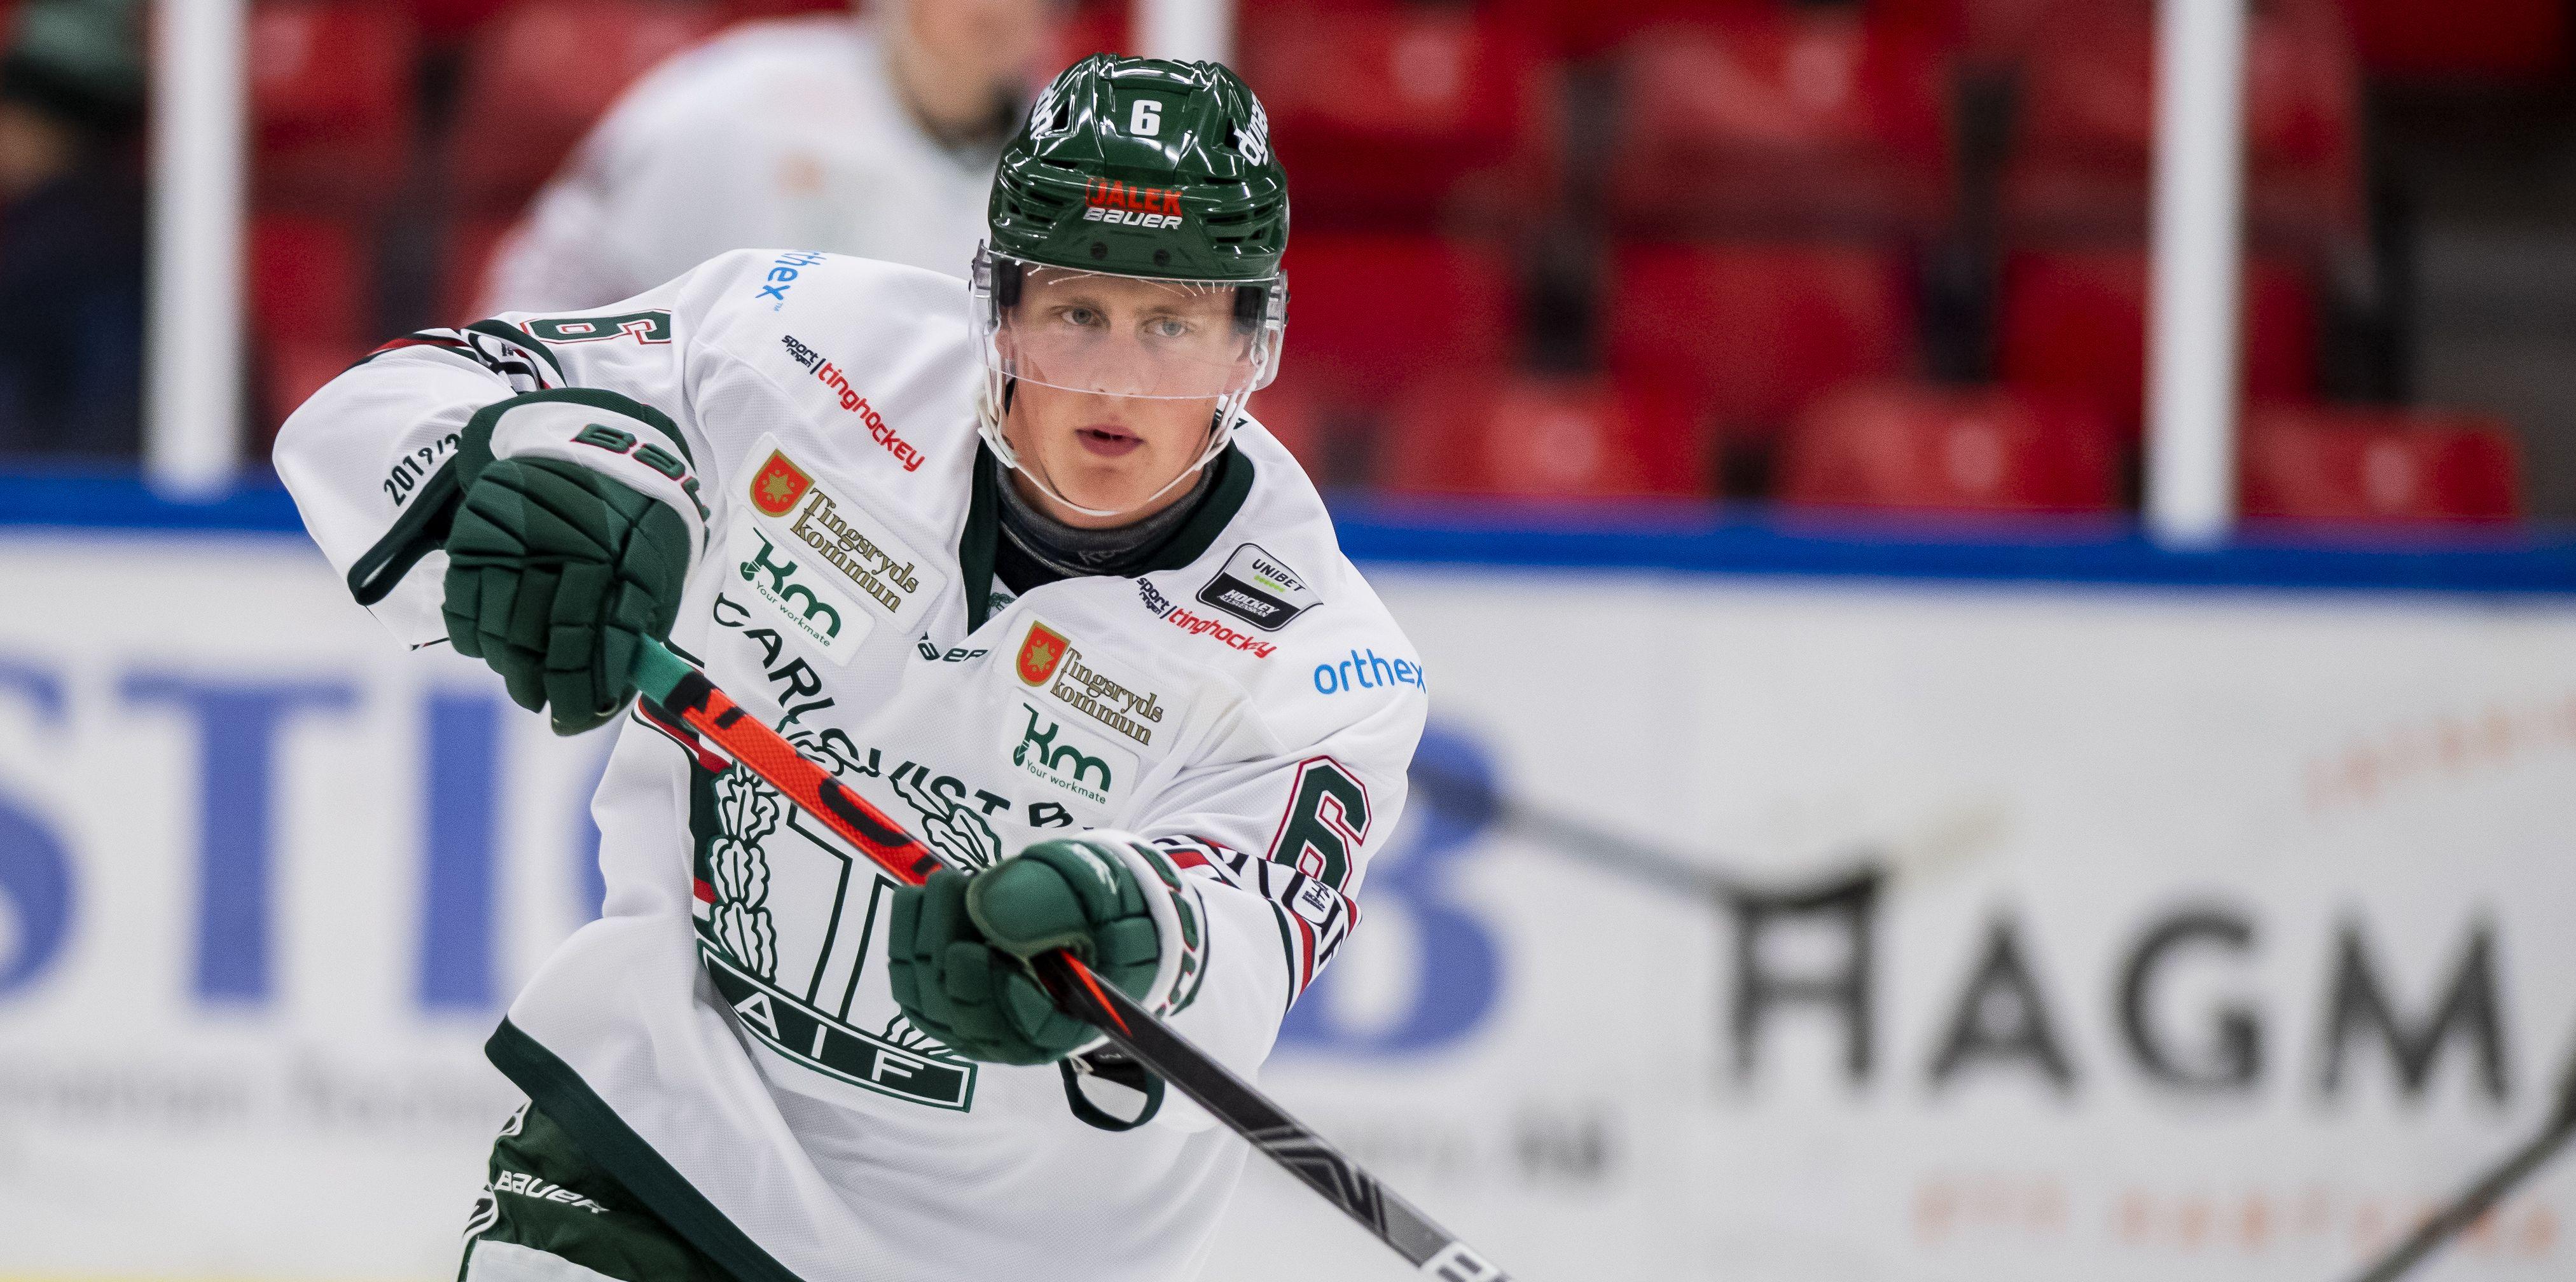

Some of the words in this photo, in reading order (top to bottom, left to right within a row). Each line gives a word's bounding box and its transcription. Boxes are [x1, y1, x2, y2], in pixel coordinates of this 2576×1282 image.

[1130, 99, 1163, 137] 6
[519, 308, 672, 345] 6
[781, 334, 819, 363] sport
[789, 507, 902, 614] kommun
[803, 486, 920, 595] Tingsryds
[1136, 577, 1170, 612] sport
[1252, 558, 1306, 592] UNIBET
[756, 581, 779, 604] Your
[779, 602, 831, 647] workmate
[1065, 645, 1163, 724] Tingsryds
[1313, 648, 1426, 695] orthex
[1050, 671, 1151, 747] kommun
[1027, 759, 1047, 778] Your
[1050, 772, 1107, 805] workmate
[1266, 754, 1372, 895] 6
